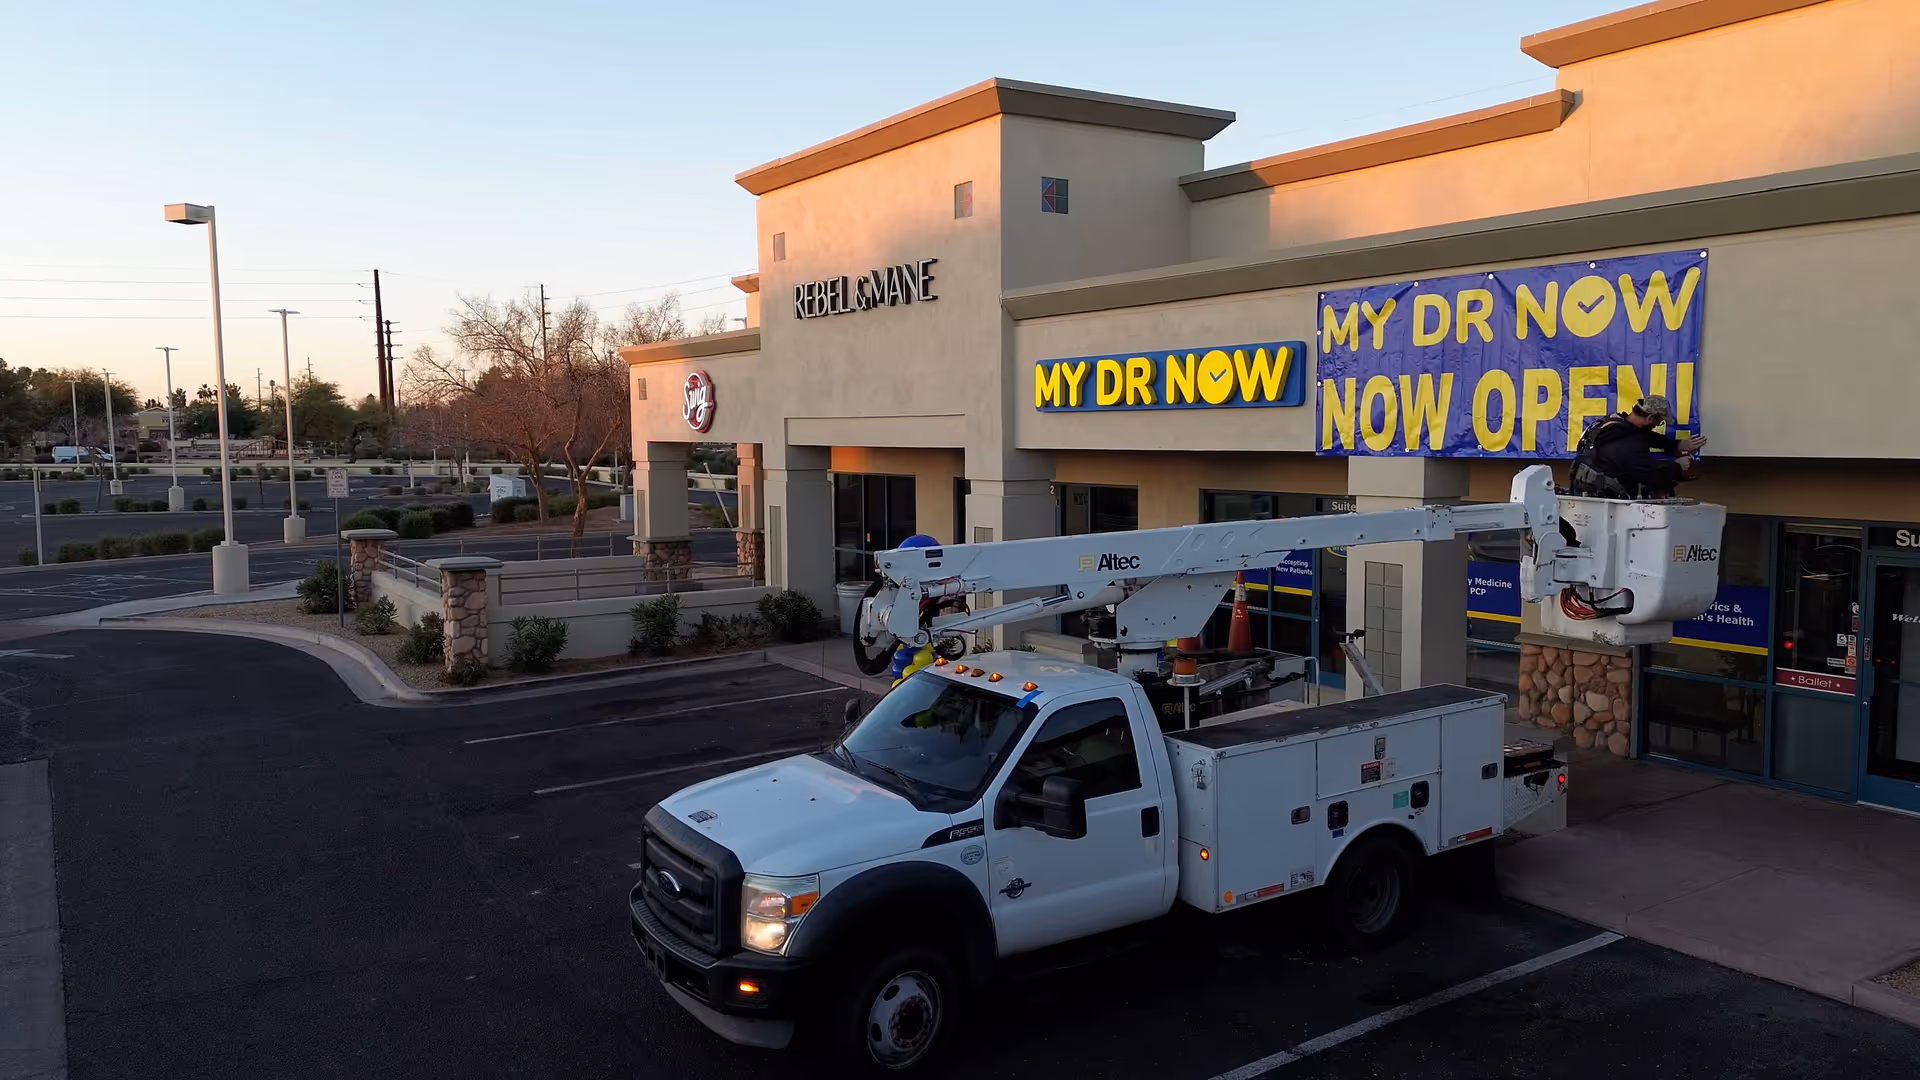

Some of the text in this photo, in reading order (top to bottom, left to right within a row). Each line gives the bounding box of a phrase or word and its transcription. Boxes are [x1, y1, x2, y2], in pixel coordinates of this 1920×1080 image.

[794, 258, 938, 319] REBEL & MANE
[1322, 266, 1701, 354] MY DR NOW
[1035, 346, 1290, 408] MY DR NOW
[1322, 372, 1454, 451] NOW
[1331, 501, 1357, 512] Suite
[1686, 545, 1717, 562] Altec
[1097, 553, 1141, 571] Altec
[1280, 559, 1308, 568] Accepting
[1289, 567, 1313, 575] Patients
[1475, 577, 1512, 588] Medicine
[1470, 587, 1486, 595] PCP
[1733, 604, 1742, 613] &
[1717, 614, 1754, 626] Health
[1892, 613, 1920, 623] Wel
[1798, 675, 1833, 688] Ballet
